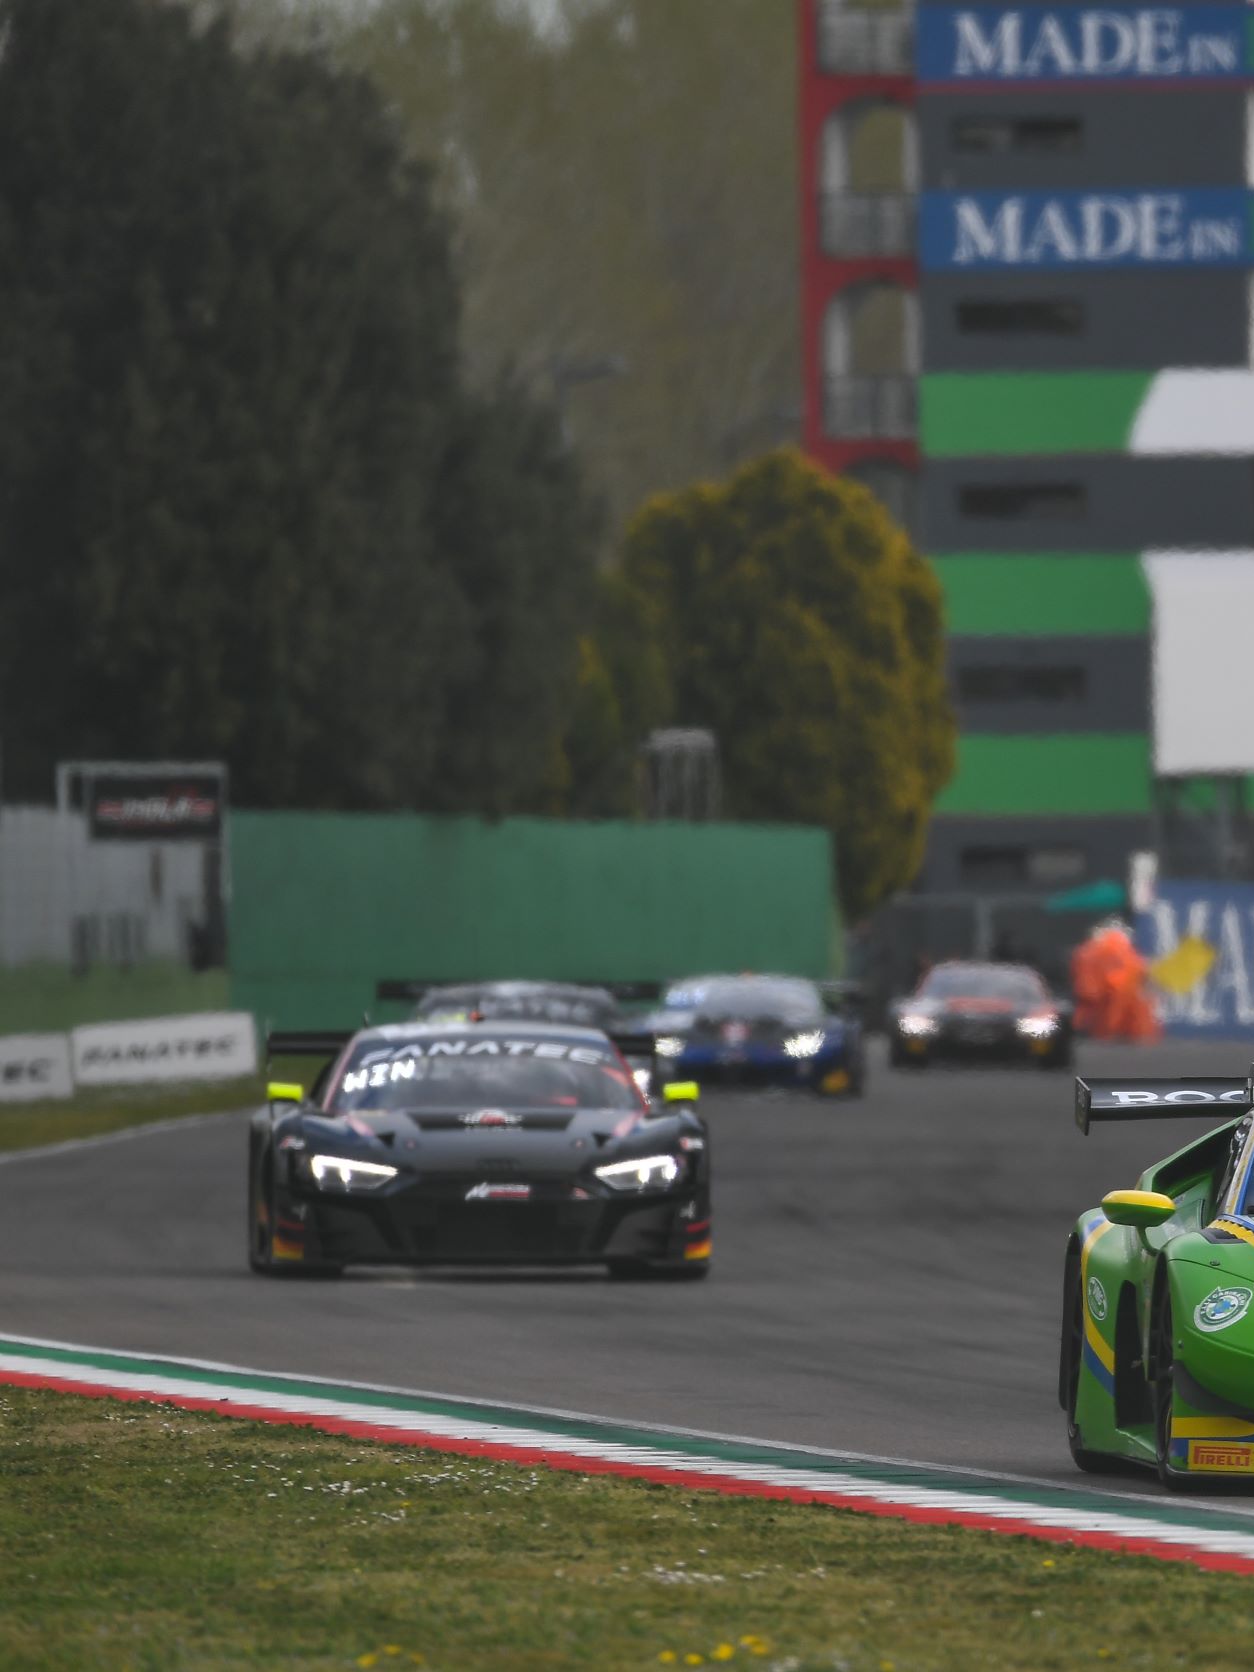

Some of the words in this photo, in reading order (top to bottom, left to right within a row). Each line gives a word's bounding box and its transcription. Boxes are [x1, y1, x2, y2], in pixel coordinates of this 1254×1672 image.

[953, 9, 1183, 75] MADE
[1188, 33, 1238, 72] IN
[953, 194, 1184, 263] MADE
[1189, 217, 1241, 260] IN
[360, 1040, 604, 1067] FANATEC
[343, 1058, 416, 1093] WIN
[1194, 1446, 1254, 1467] PIRELLI
